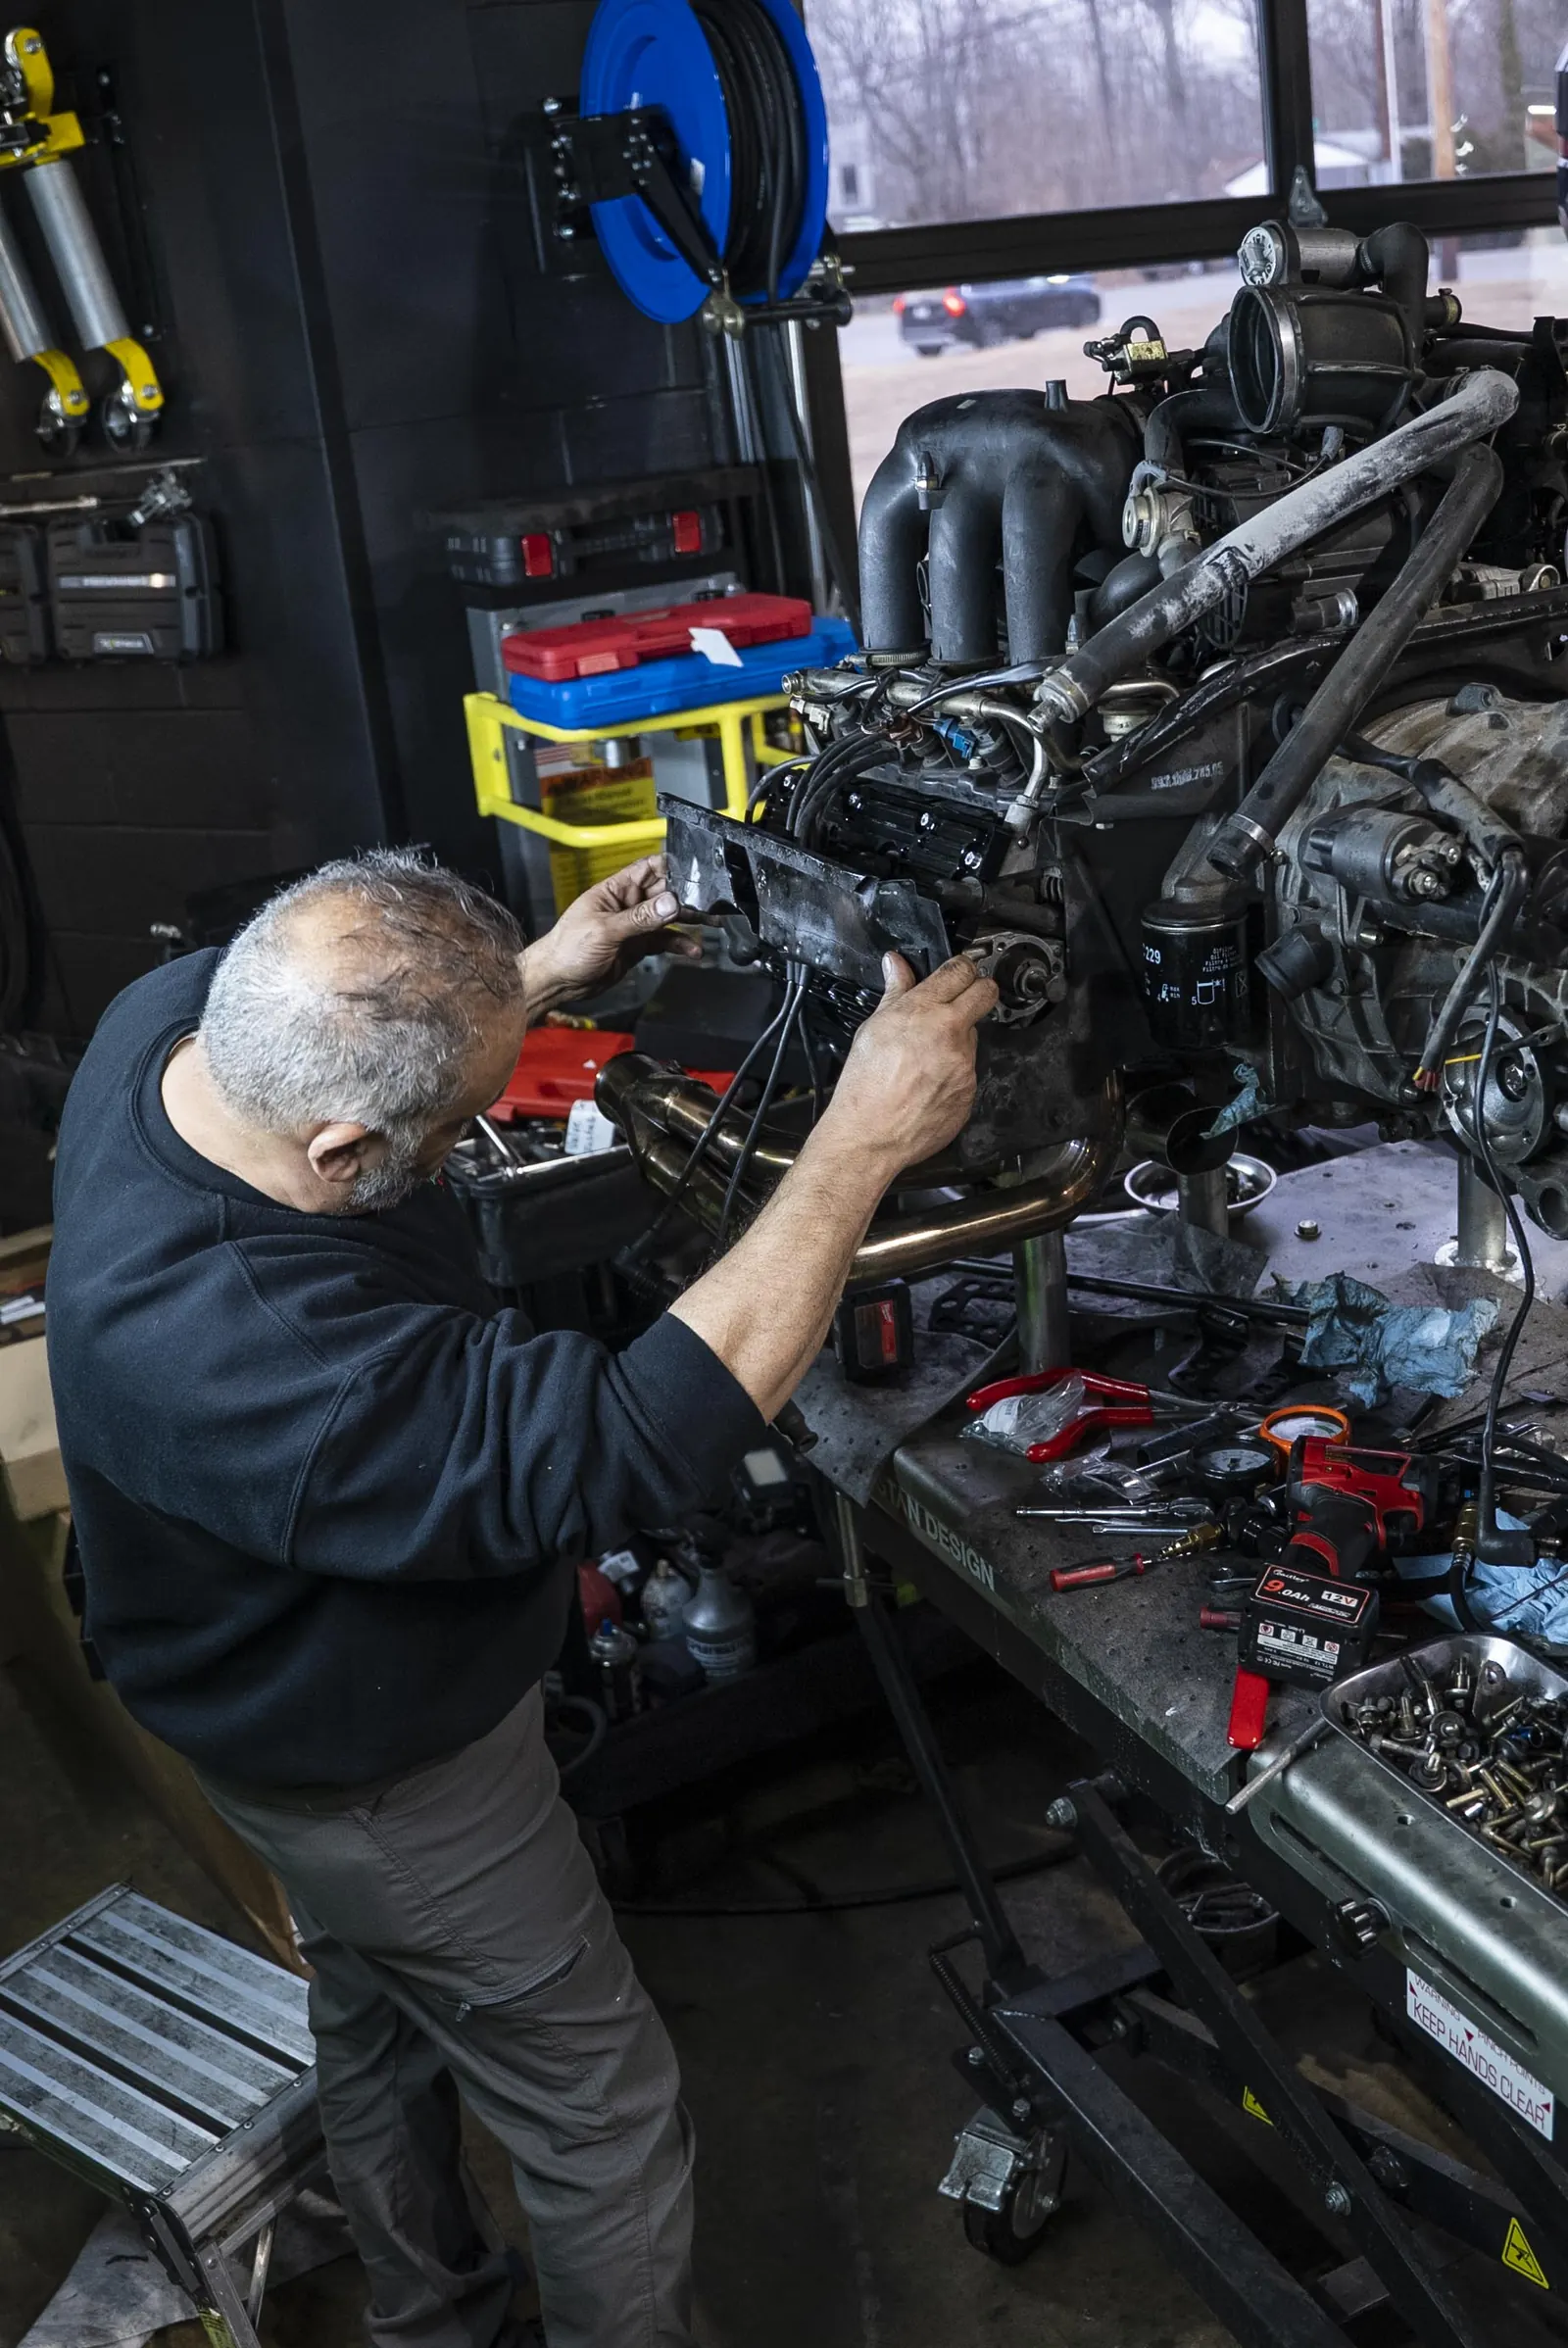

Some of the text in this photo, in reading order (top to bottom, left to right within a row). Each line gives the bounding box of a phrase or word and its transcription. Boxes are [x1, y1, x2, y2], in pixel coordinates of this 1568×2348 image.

[1145, 946, 1161, 964] 229
[1191, 996, 1198, 1005] 5
[925, 1510, 996, 1592] DESIGN
[1323, 1591, 1356, 1606] 12V
[1414, 1975, 1461, 2023] WARNING
[1477, 2029, 1510, 2063] PINCH
[1413, 1997, 1544, 2130] KEEP HANDS CLEAR
